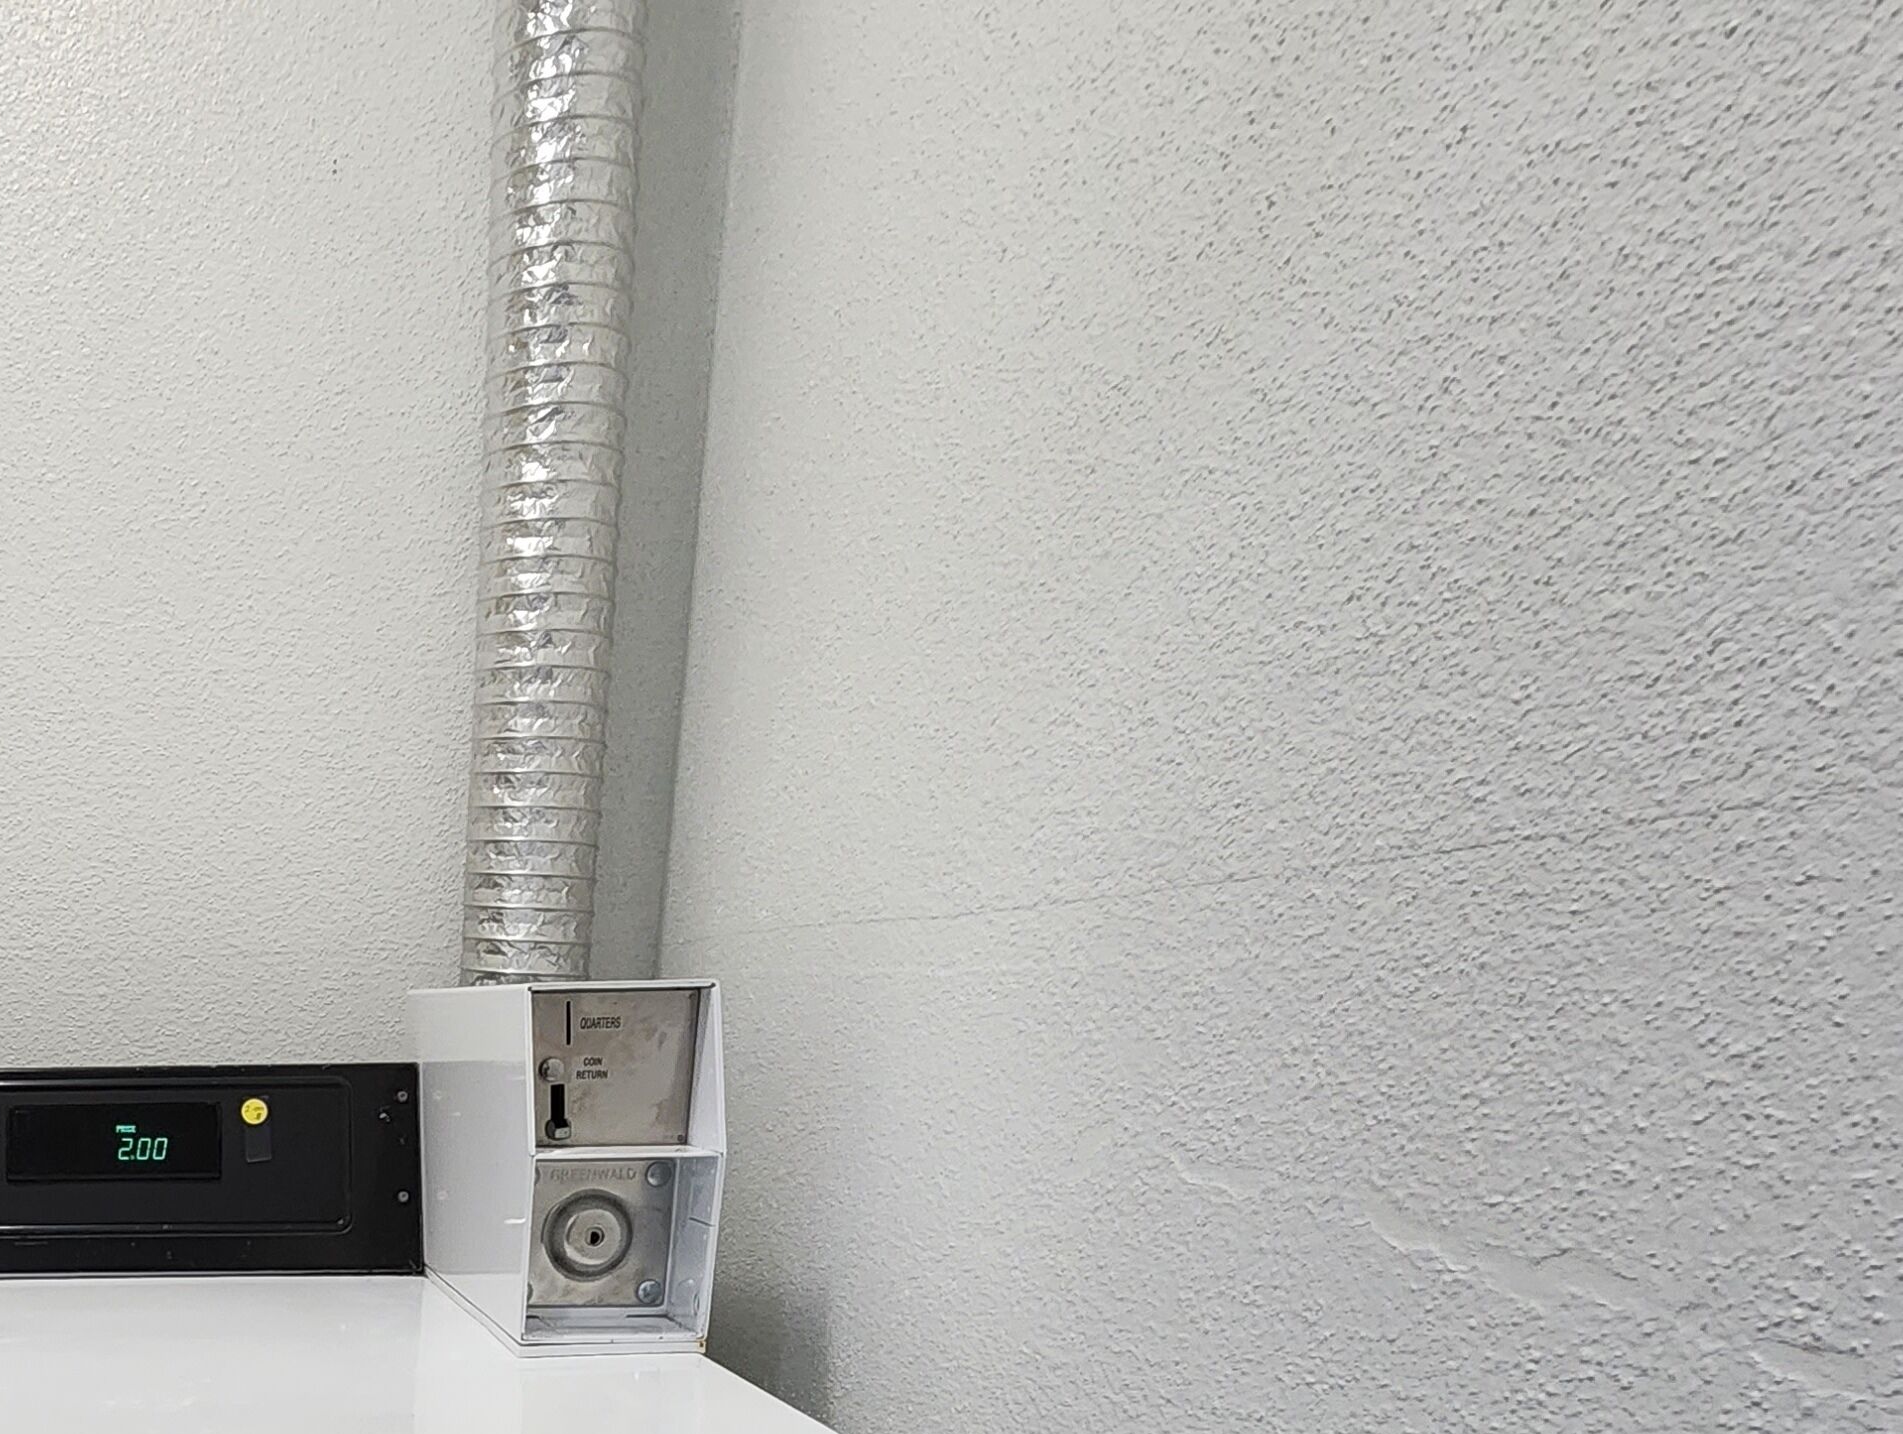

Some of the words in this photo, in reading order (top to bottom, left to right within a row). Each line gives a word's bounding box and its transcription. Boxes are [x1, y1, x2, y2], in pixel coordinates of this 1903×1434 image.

[580, 1016, 622, 1030] QUARTERS
[583, 1057, 603, 1067] COIN
[576, 1069, 609, 1080] RETURN
[118, 1137, 168, 1160] 2.00
[550, 1167, 637, 1181] GREENWALD
